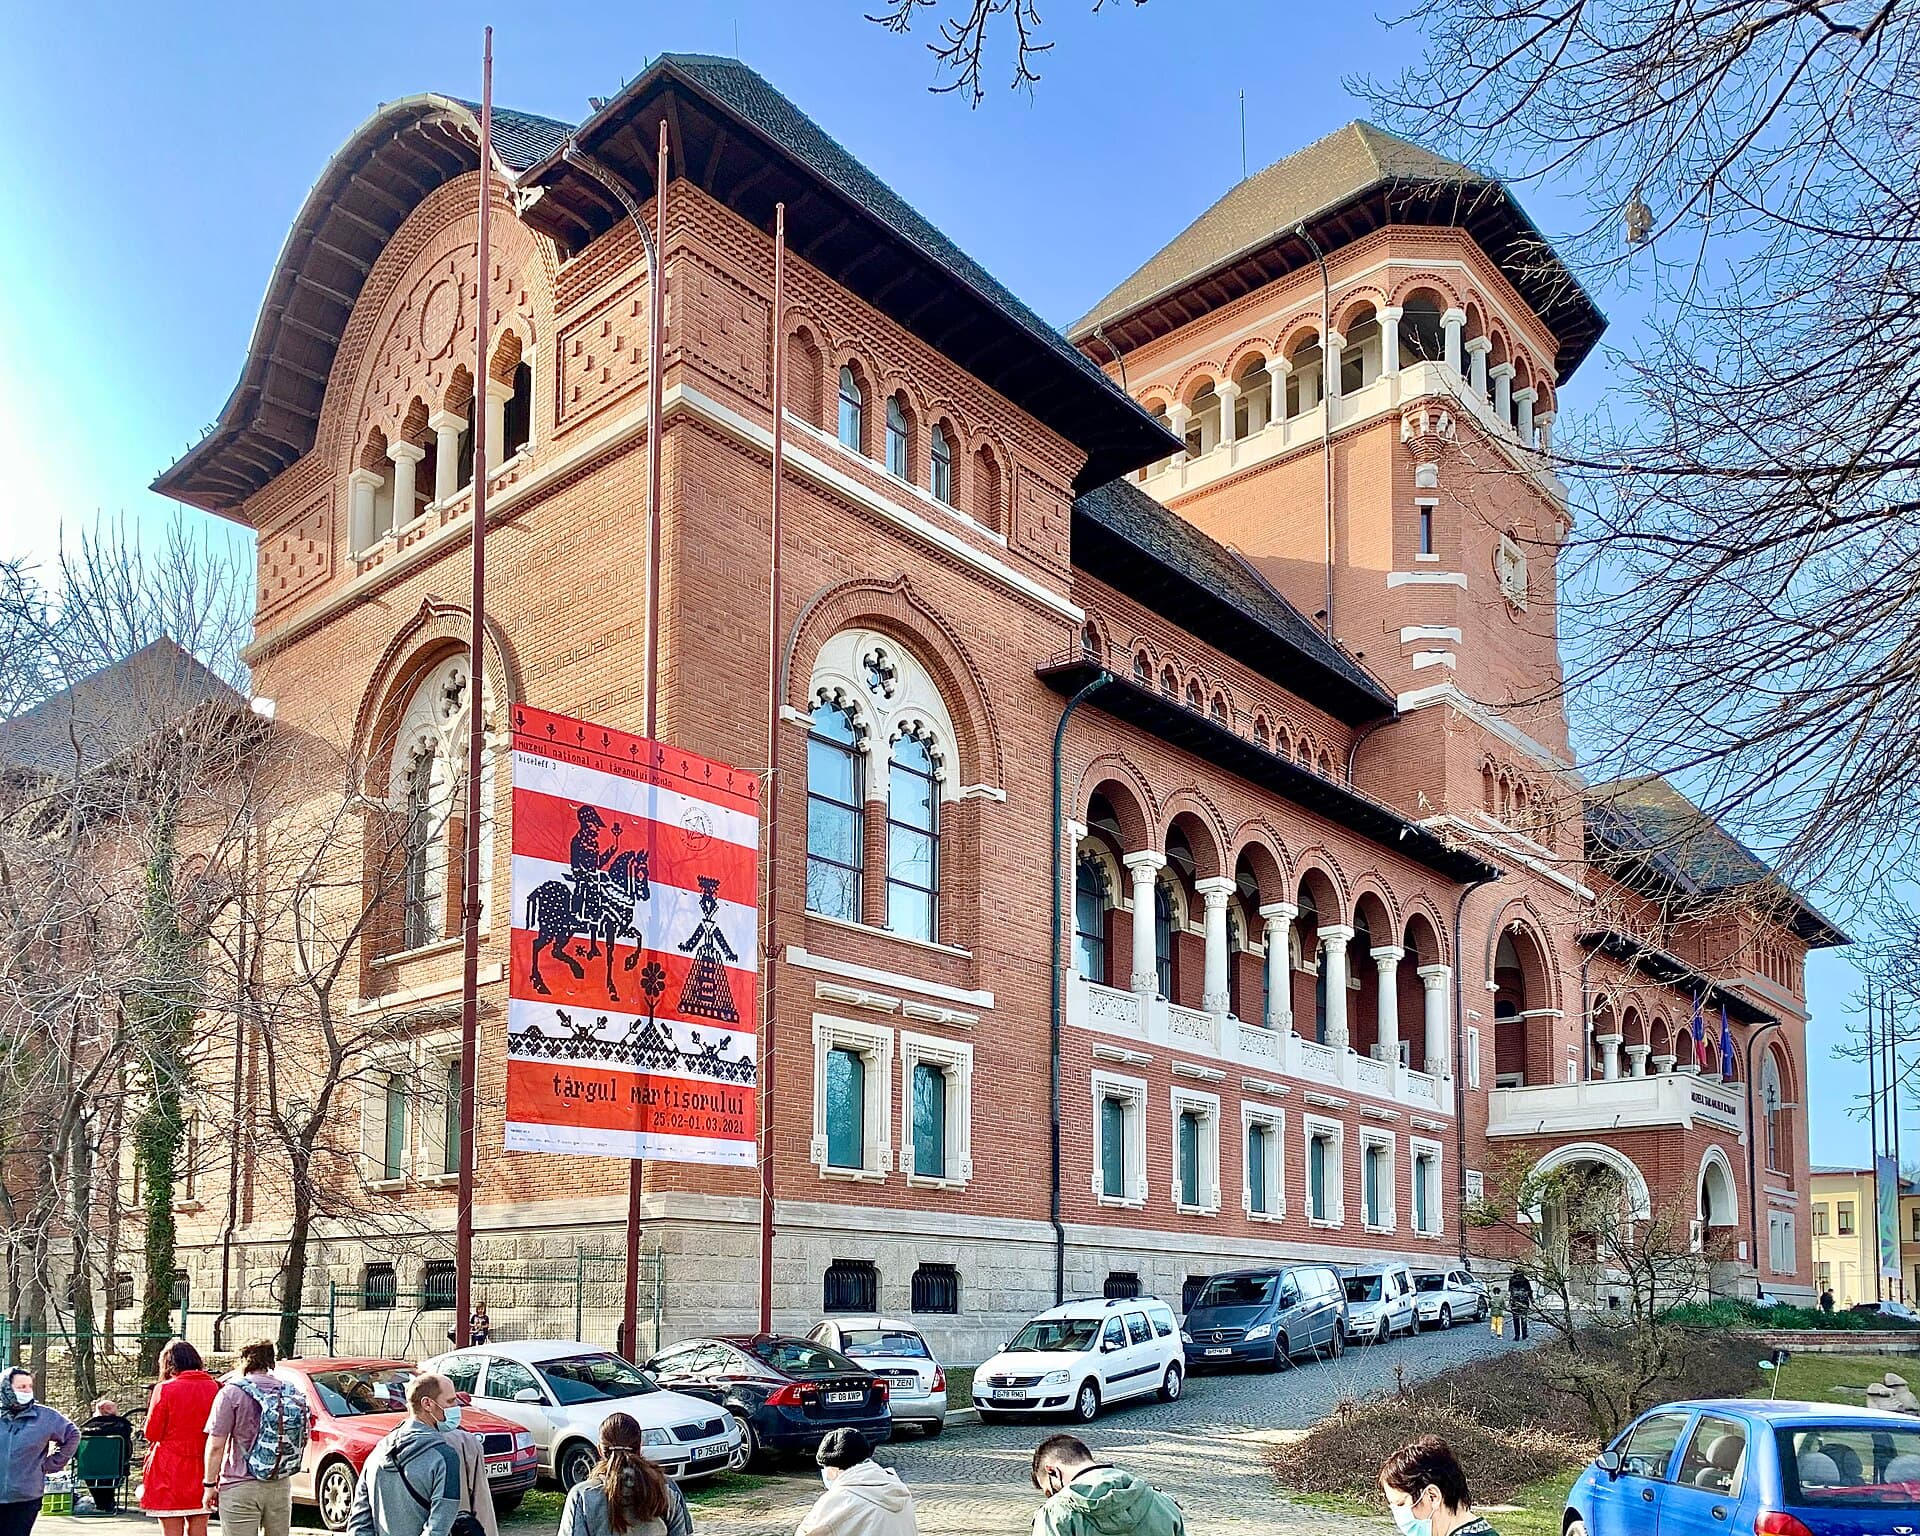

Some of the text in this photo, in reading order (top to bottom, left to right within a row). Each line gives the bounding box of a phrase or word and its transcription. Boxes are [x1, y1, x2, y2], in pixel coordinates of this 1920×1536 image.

[595, 760, 604, 769] al
[553, 1072, 616, 1102] târgul
[653, 1112, 744, 1134] 25.02-01.03.2021
